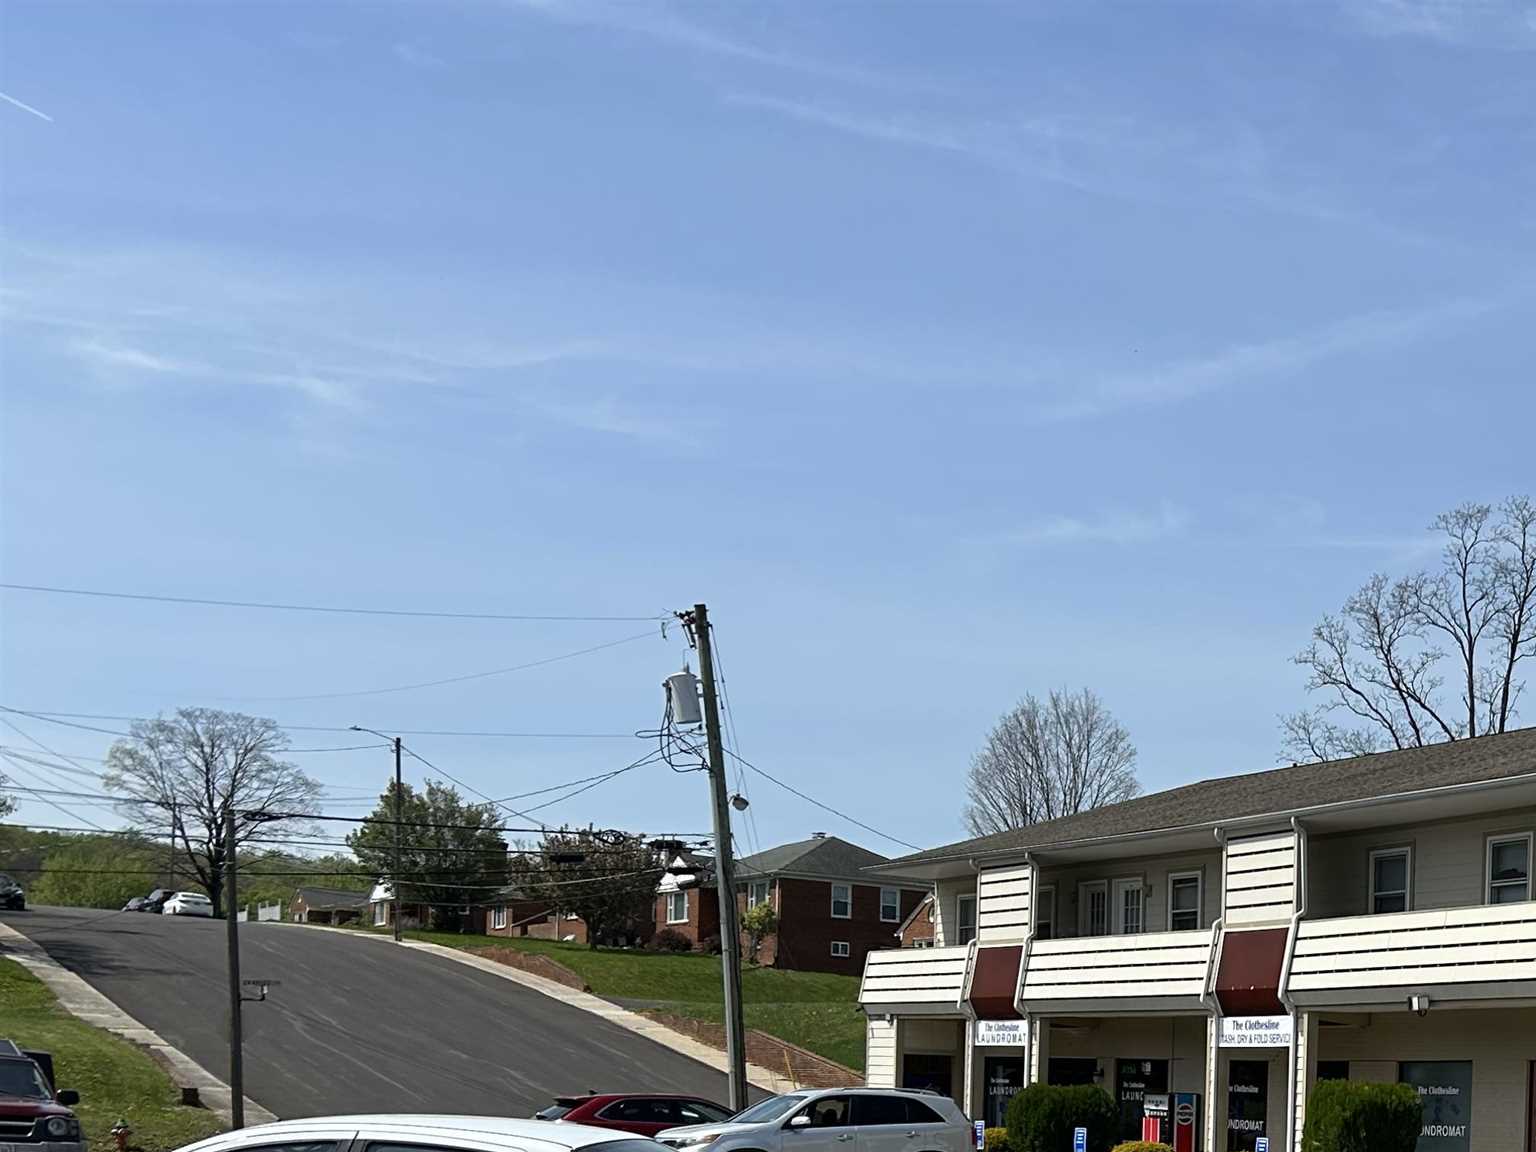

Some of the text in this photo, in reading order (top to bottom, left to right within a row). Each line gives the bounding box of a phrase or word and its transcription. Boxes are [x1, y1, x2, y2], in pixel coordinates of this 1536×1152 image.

[1232, 1020, 1244, 1031] The
[976, 1033, 1026, 1043] LAUNDROMAT
[1227, 1119, 1264, 1131] NDROMAT
[1419, 1125, 1466, 1136] NDROMAT
